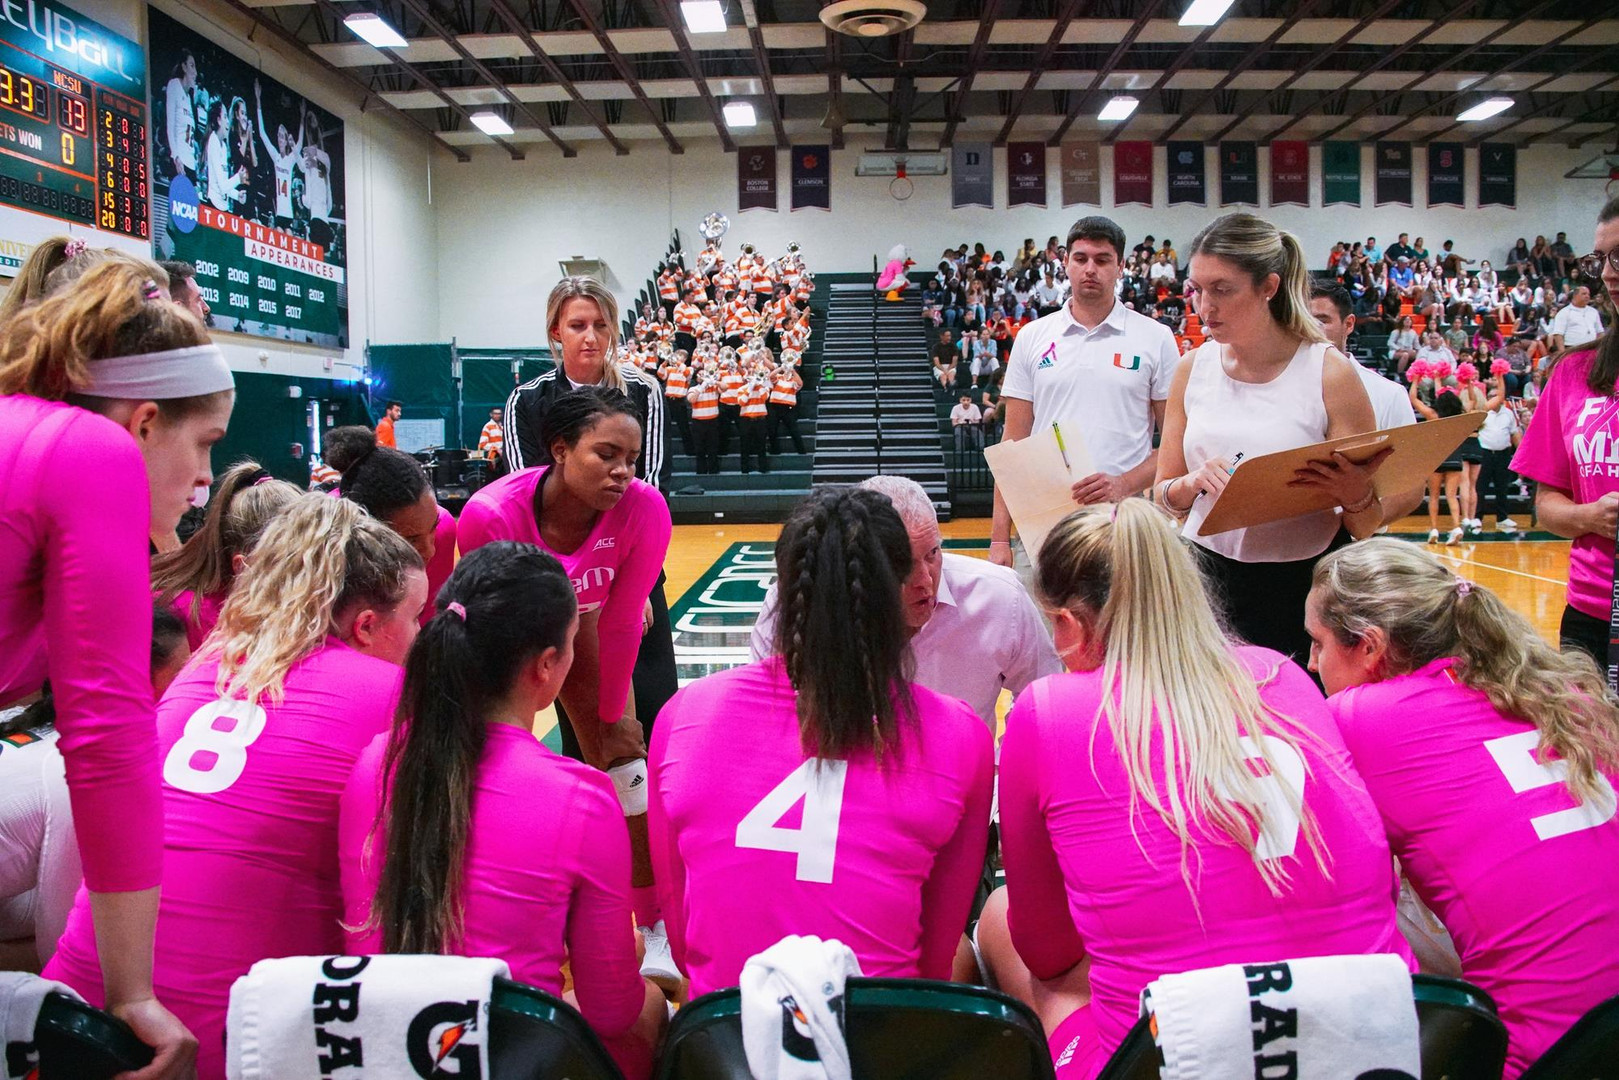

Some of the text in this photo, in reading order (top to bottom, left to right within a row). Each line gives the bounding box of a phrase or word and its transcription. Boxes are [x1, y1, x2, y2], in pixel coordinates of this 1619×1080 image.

[53, 69, 82, 94] NCSU
[67, 99, 86, 132] 13
[105, 111, 112, 128] 2
[18, 128, 42, 151] WON
[61, 132, 75, 166] 0
[106, 130, 113, 148] 3
[107, 171, 115, 188] 6
[139, 163, 145, 180] 5
[104, 192, 115, 209] 15
[124, 197, 131, 213] 3
[171, 200, 199, 222] NCAA
[101, 209, 116, 229] 20
[204, 208, 318, 259] TOURNAMENT
[250, 244, 335, 279] APPEARANCES
[196, 259, 325, 303] 2002 2009 2010 2011 2012
[229, 292, 249, 309] 2014
[258, 299, 277, 314] 2015
[285, 305, 302, 319] 2017
[593, 537, 615, 551] ACC
[163, 699, 267, 793] 8
[1214, 734, 1306, 861] 9
[1483, 729, 1618, 841] 5
[735, 757, 848, 884] 4
